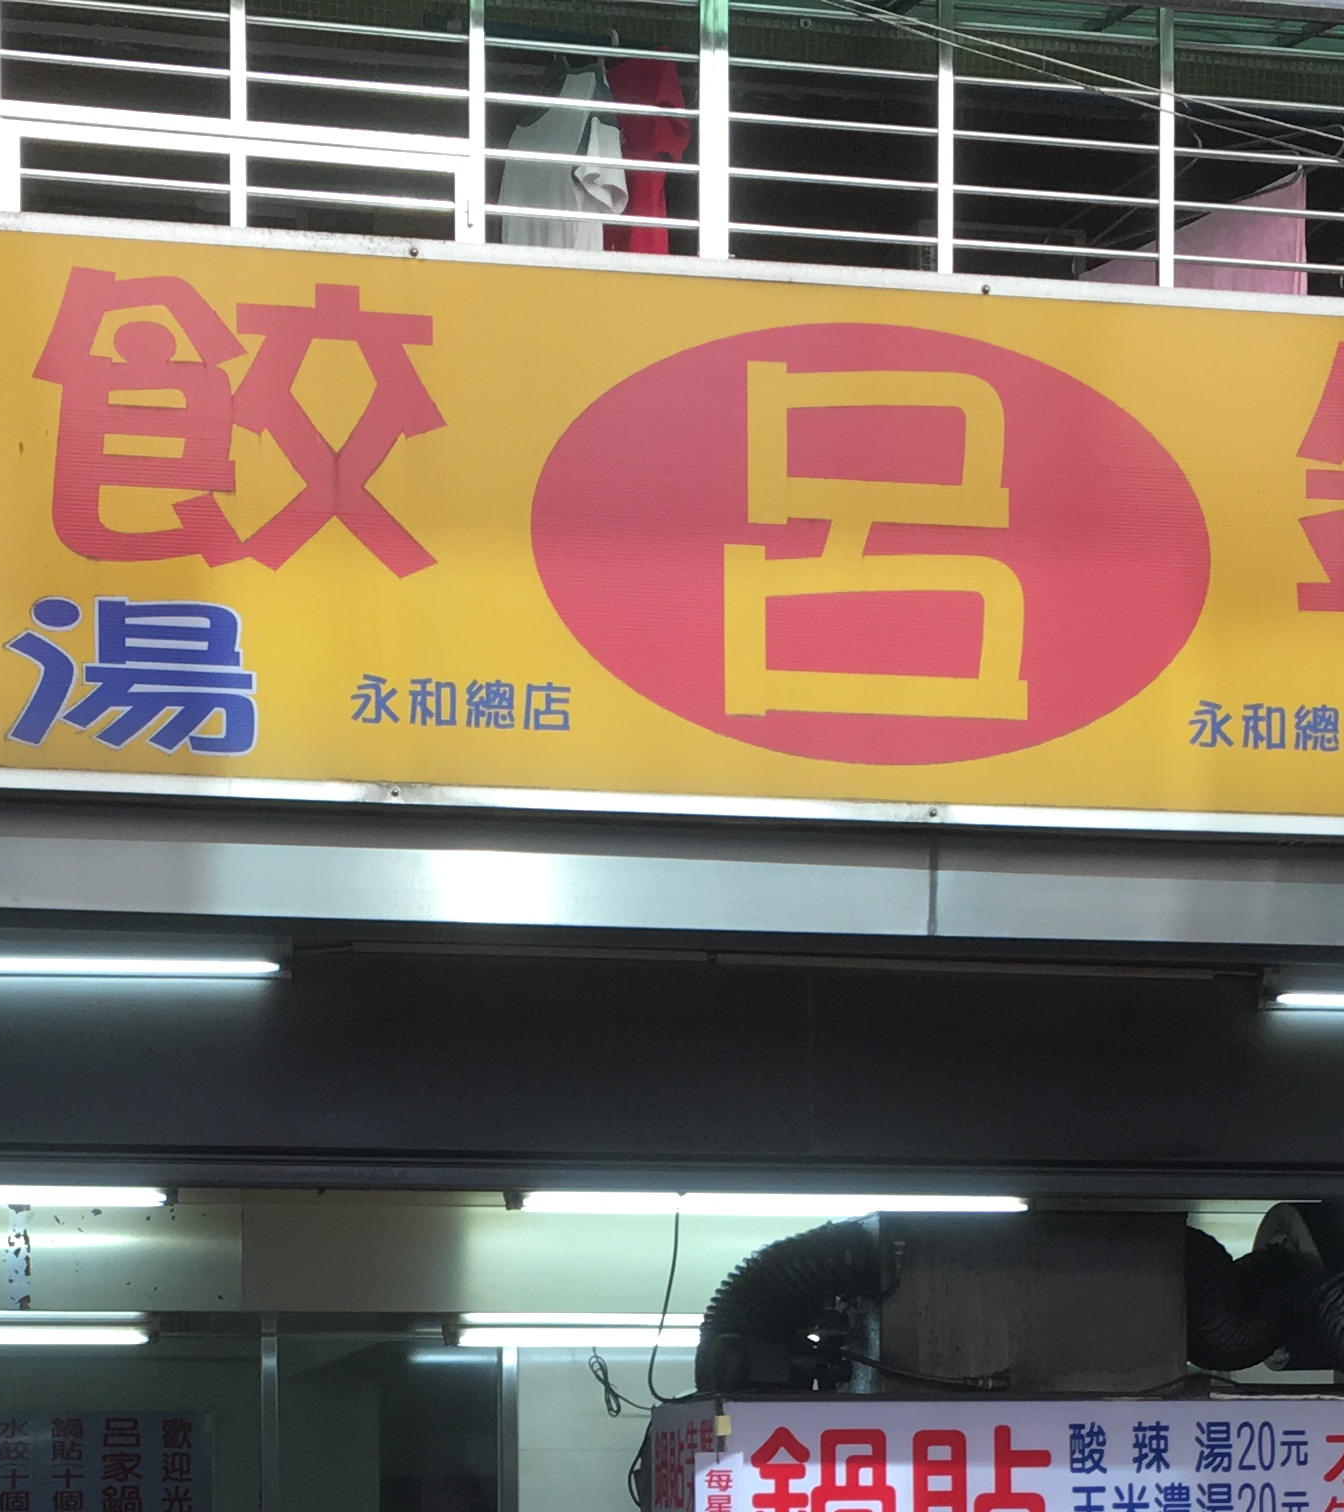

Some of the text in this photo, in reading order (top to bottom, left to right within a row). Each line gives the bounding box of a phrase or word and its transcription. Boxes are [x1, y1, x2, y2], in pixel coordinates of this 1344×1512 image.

[722, 360, 1030, 720] 呂
[350, 672, 572, 734] 永和總店
